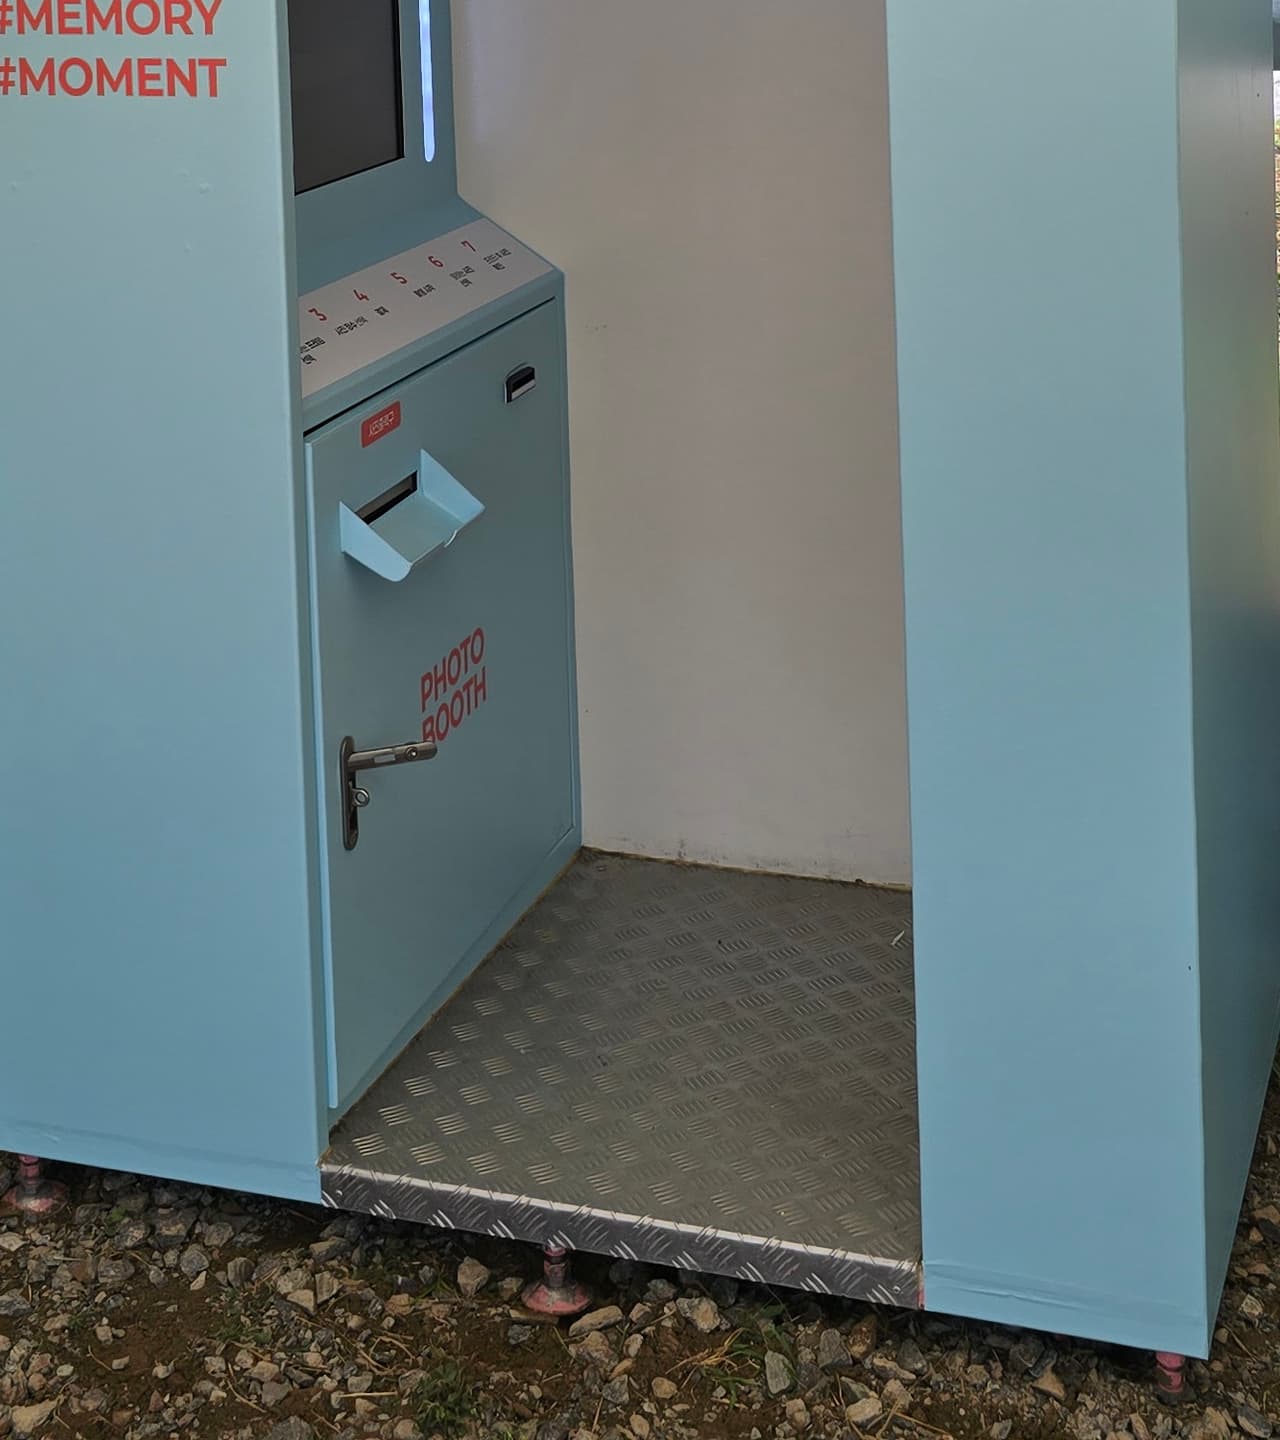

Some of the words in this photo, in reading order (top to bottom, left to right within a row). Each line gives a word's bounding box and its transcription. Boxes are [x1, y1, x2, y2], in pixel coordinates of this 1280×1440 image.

[461, 240, 476, 252] 7
[428, 255, 444, 268] 6
[390, 271, 408, 285] 5
[353, 289, 370, 302] 4
[308, 307, 328, 322] 3
[421, 627, 485, 712] PHOTO
[422, 666, 487, 744] BOOTH
